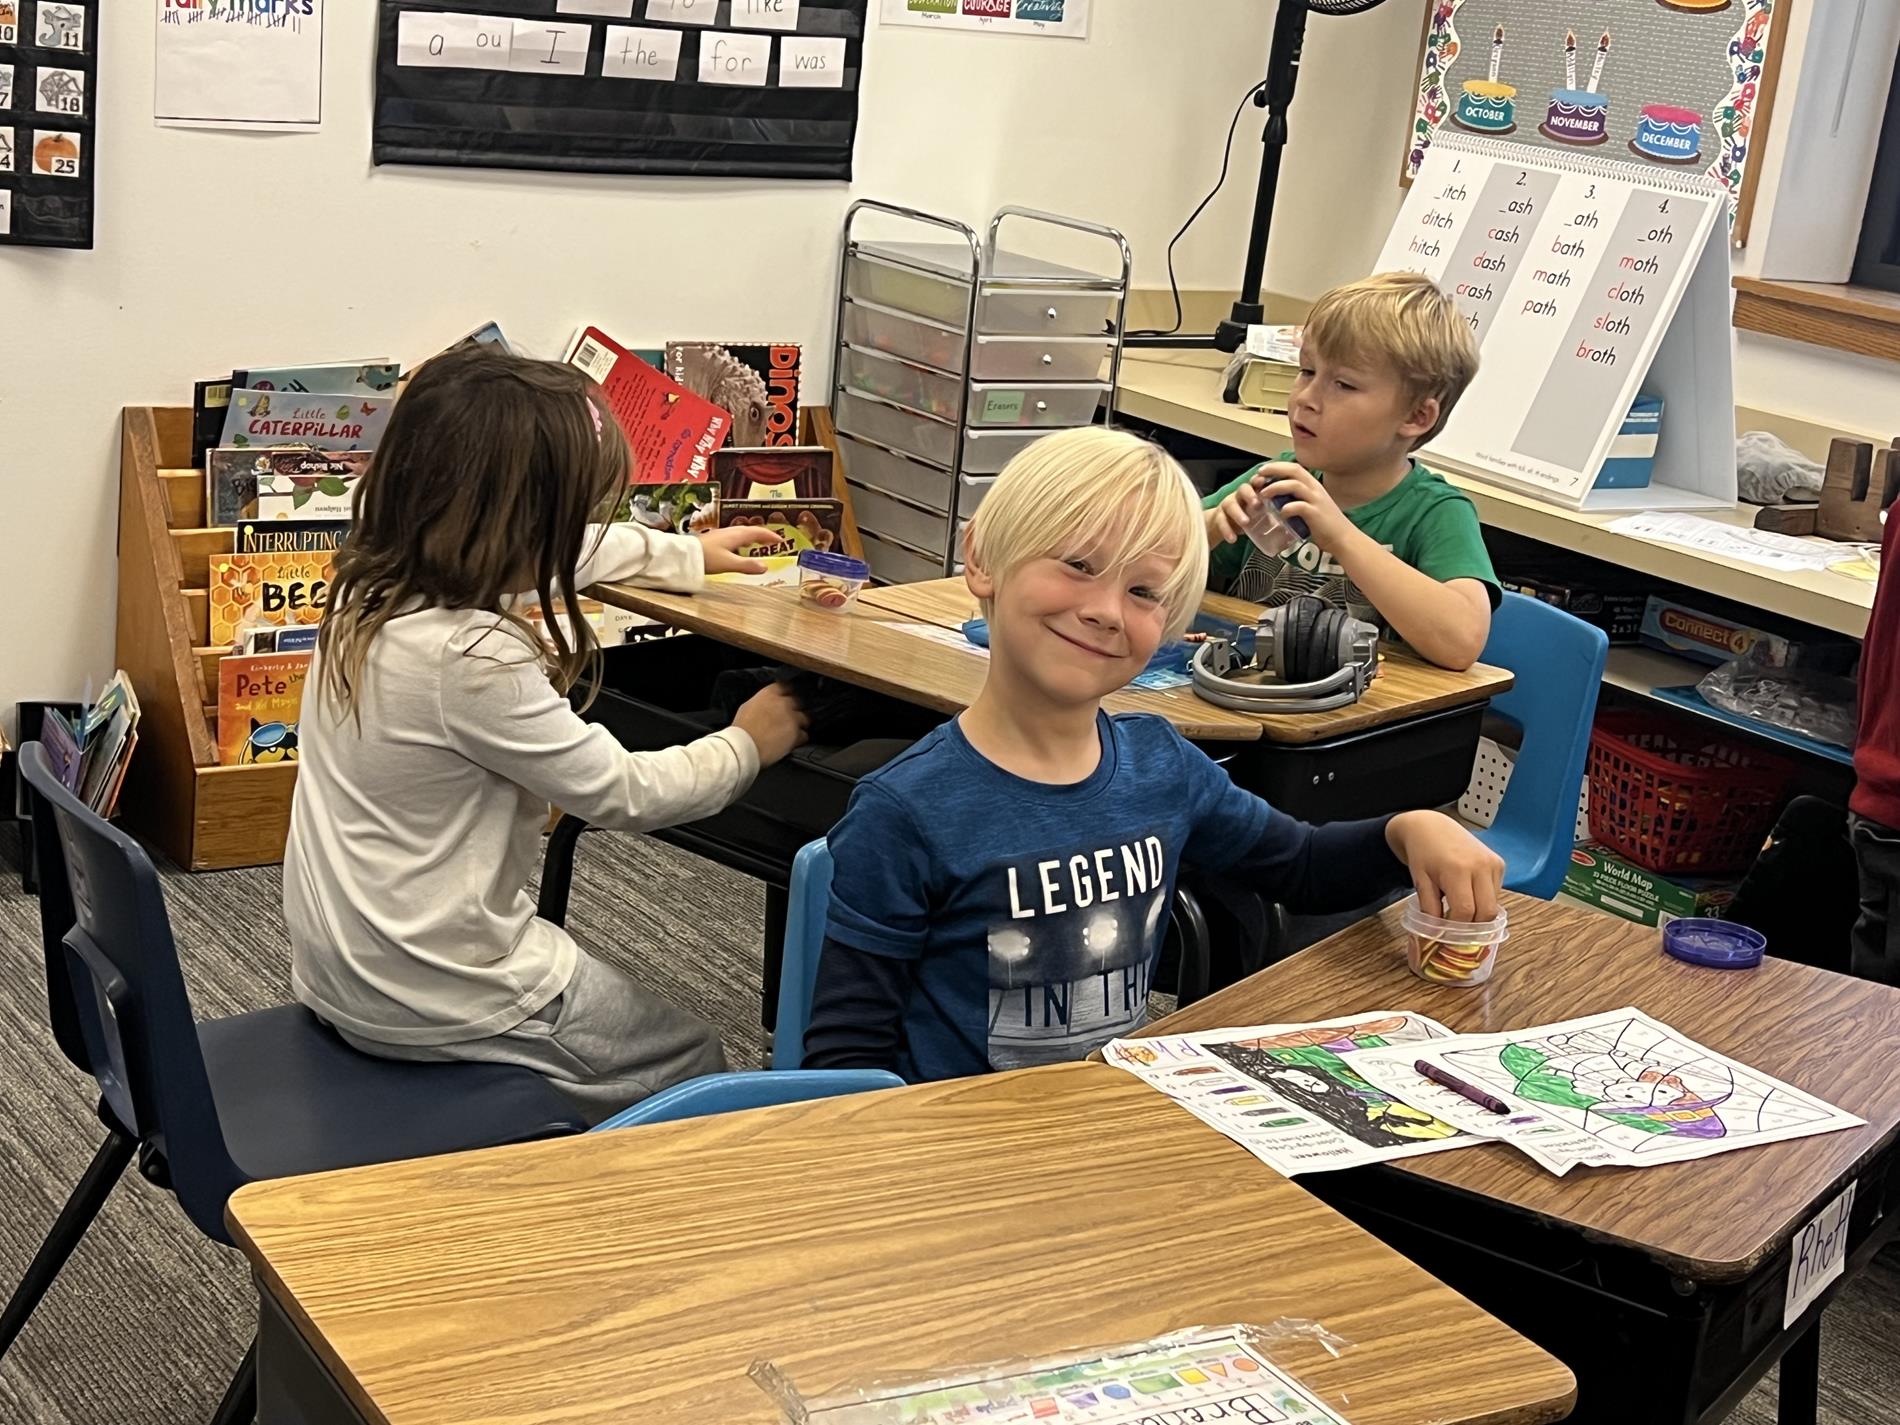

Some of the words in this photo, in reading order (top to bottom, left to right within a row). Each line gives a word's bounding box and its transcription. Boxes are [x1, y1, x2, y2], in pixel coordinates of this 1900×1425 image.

[62, 31, 80, 48] 11
[428, 33, 444, 57] a
[540, 29, 567, 64] I
[619, 36, 659, 66] the
[710, 39, 753, 73] for
[794, 54, 827, 72] was
[61, 97, 80, 112] 18
[1465, 106, 1505, 121] OCTOBER
[1550, 116, 1600, 132] NOVEMBER
[1642, 133, 1692, 151] DECEMBER
[54, 159, 76, 174] 25
[1515, 171, 1528, 187] 2.
[1584, 184, 1597, 200] 3.
[1657, 198, 1670, 215] 4.
[1421, 208, 1454, 230] ditch
[1487, 225, 1520, 245] cash
[1408, 235, 1441, 258] hitch
[1551, 234, 1585, 259] bath
[1472, 250, 1507, 273] dash
[1618, 255, 1660, 276] moth
[1532, 268, 1572, 288] math
[1455, 282, 1493, 302] crash
[1606, 281, 1646, 306] cloth
[1521, 297, 1557, 318] path
[1593, 311, 1631, 336] sloth
[1575, 338, 1617, 367] broth
[292, 407, 327, 420] Little
[986, 400, 1019, 412] Erasers
[748, 539, 796, 558] GREAT
[276, 565, 311, 579] Little
[1664, 610, 1729, 645] Connect
[236, 674, 287, 698] Pete
[1007, 835, 1164, 919] LEGEND
[1603, 861, 1631, 881] World
[1631, 873, 1654, 892] Map
[1025, 980, 1067, 1028] IN
[1792, 1188, 1854, 1300] Rhett
